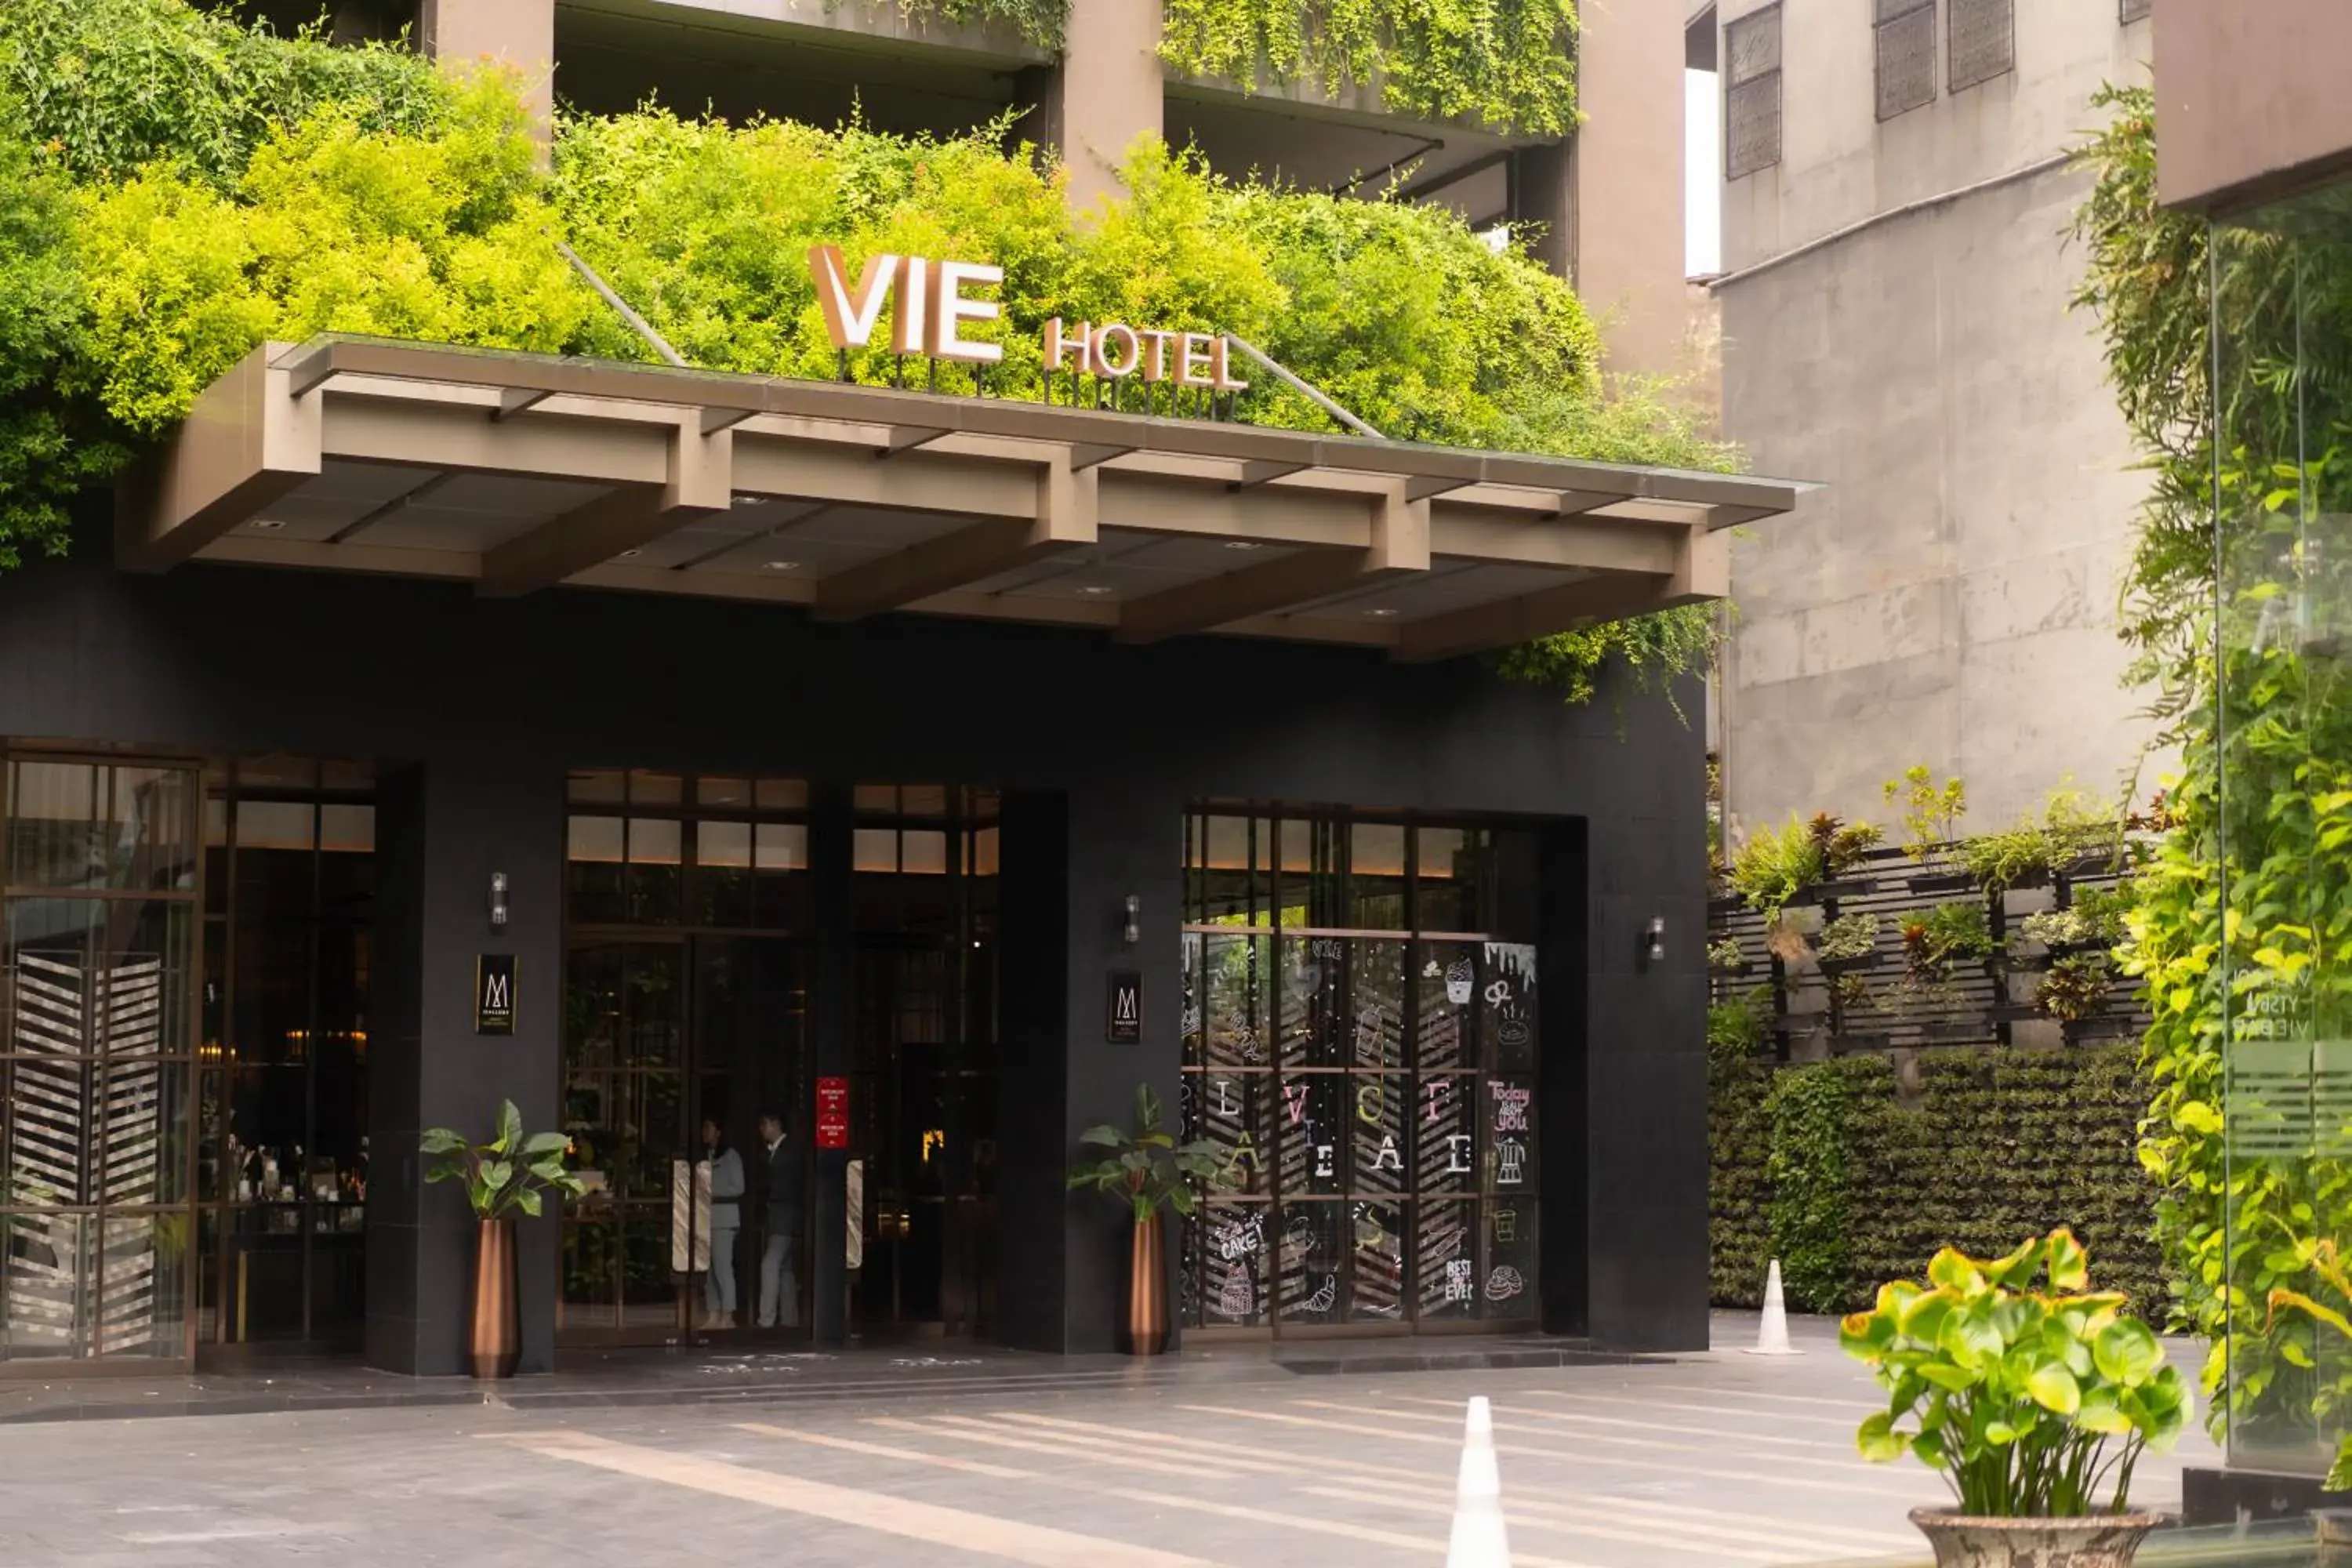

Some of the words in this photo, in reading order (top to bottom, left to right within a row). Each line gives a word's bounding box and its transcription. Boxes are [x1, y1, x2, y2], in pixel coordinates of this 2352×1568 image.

[808, 245, 1003, 363] VIE
[1044, 317, 1249, 390] HOTEL
[1487, 1080, 1530, 1107] Today
[1446, 1259, 1472, 1277] BEST
